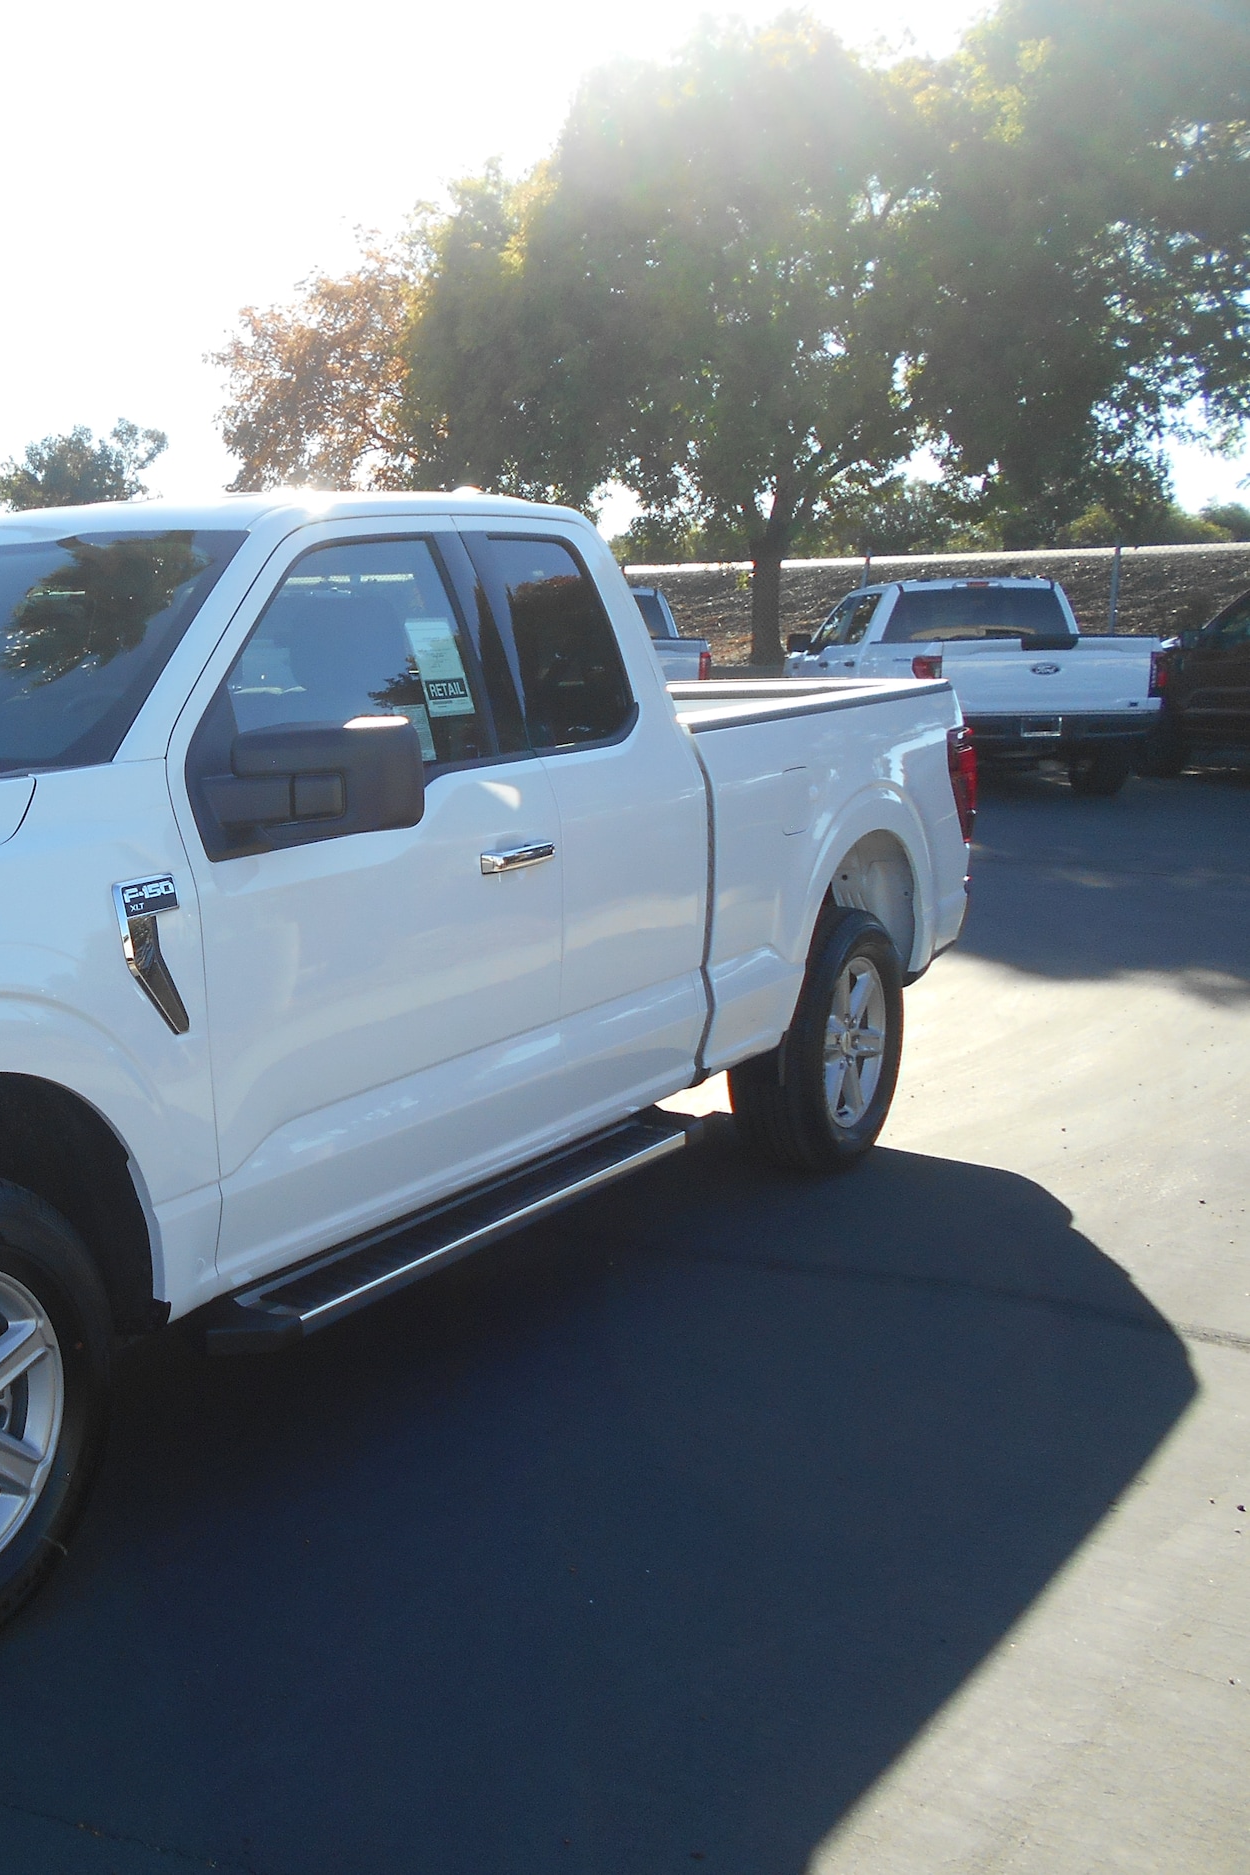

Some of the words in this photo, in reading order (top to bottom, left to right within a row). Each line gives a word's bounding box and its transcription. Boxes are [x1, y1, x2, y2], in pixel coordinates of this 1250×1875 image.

[429, 681, 465, 697] RETAIL
[123, 880, 175, 903] F-150
[130, 902, 144, 912] XLT
